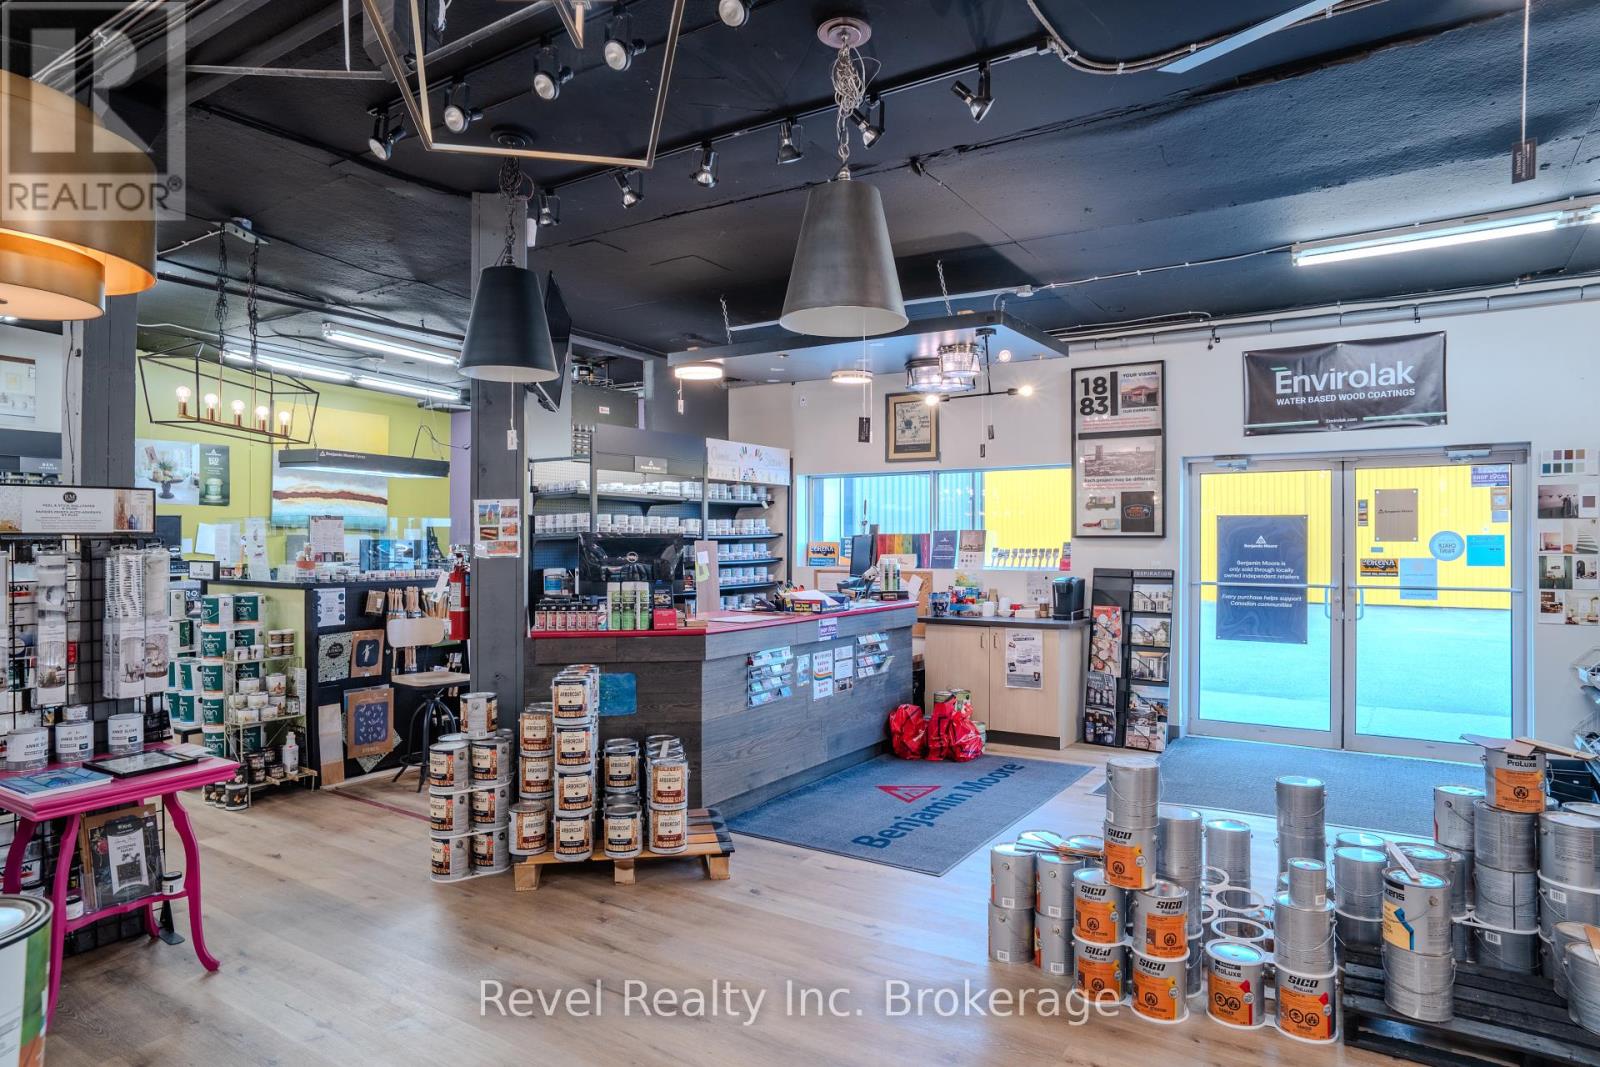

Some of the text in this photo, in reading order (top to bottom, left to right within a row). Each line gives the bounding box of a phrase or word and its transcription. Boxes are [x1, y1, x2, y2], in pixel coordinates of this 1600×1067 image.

[1270, 361, 1416, 395] Envirolak
[1276, 388, 1416, 406] WATER BASED WOOD COATINGS
[204, 641, 220, 649] ben
[206, 741, 222, 749] ben
[1507, 759, 1537, 768] ProLuxe
[851, 762, 1025, 849] Benjamin Moore
[1107, 828, 1133, 840] SICO
[1080, 885, 1107, 897] SICO
[1155, 900, 1183, 910] SICO
[1084, 946, 1112, 957] SICO
[1138, 958, 1166, 972] SICO
[1214, 965, 1242, 978] ProLuxe
[1287, 975, 1319, 989] SICO
[1293, 986, 1314, 994] ProLuxe
